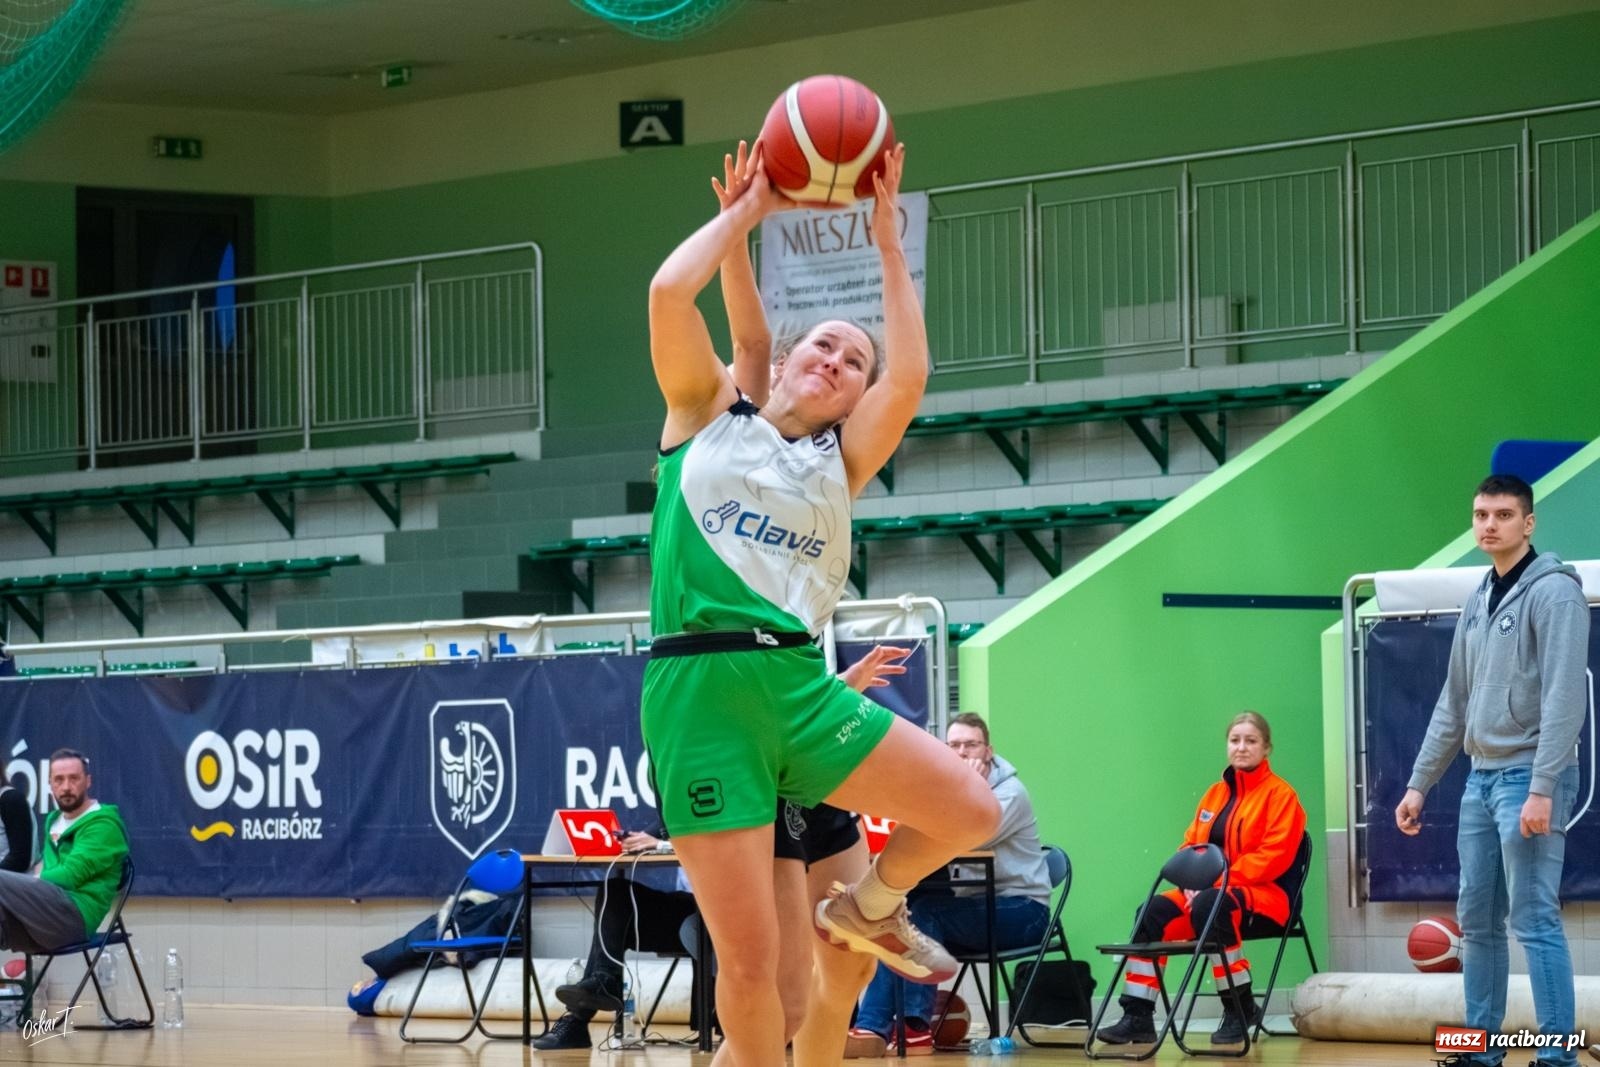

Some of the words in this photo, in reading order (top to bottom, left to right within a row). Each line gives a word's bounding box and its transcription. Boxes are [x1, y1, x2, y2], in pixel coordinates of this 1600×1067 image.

[629, 115, 673, 142] A
[734, 511, 826, 559] Clavis
[185, 728, 322, 809] OSiR
[687, 777, 724, 818] 3
[241, 811, 323, 840] RACIBÓRZ
